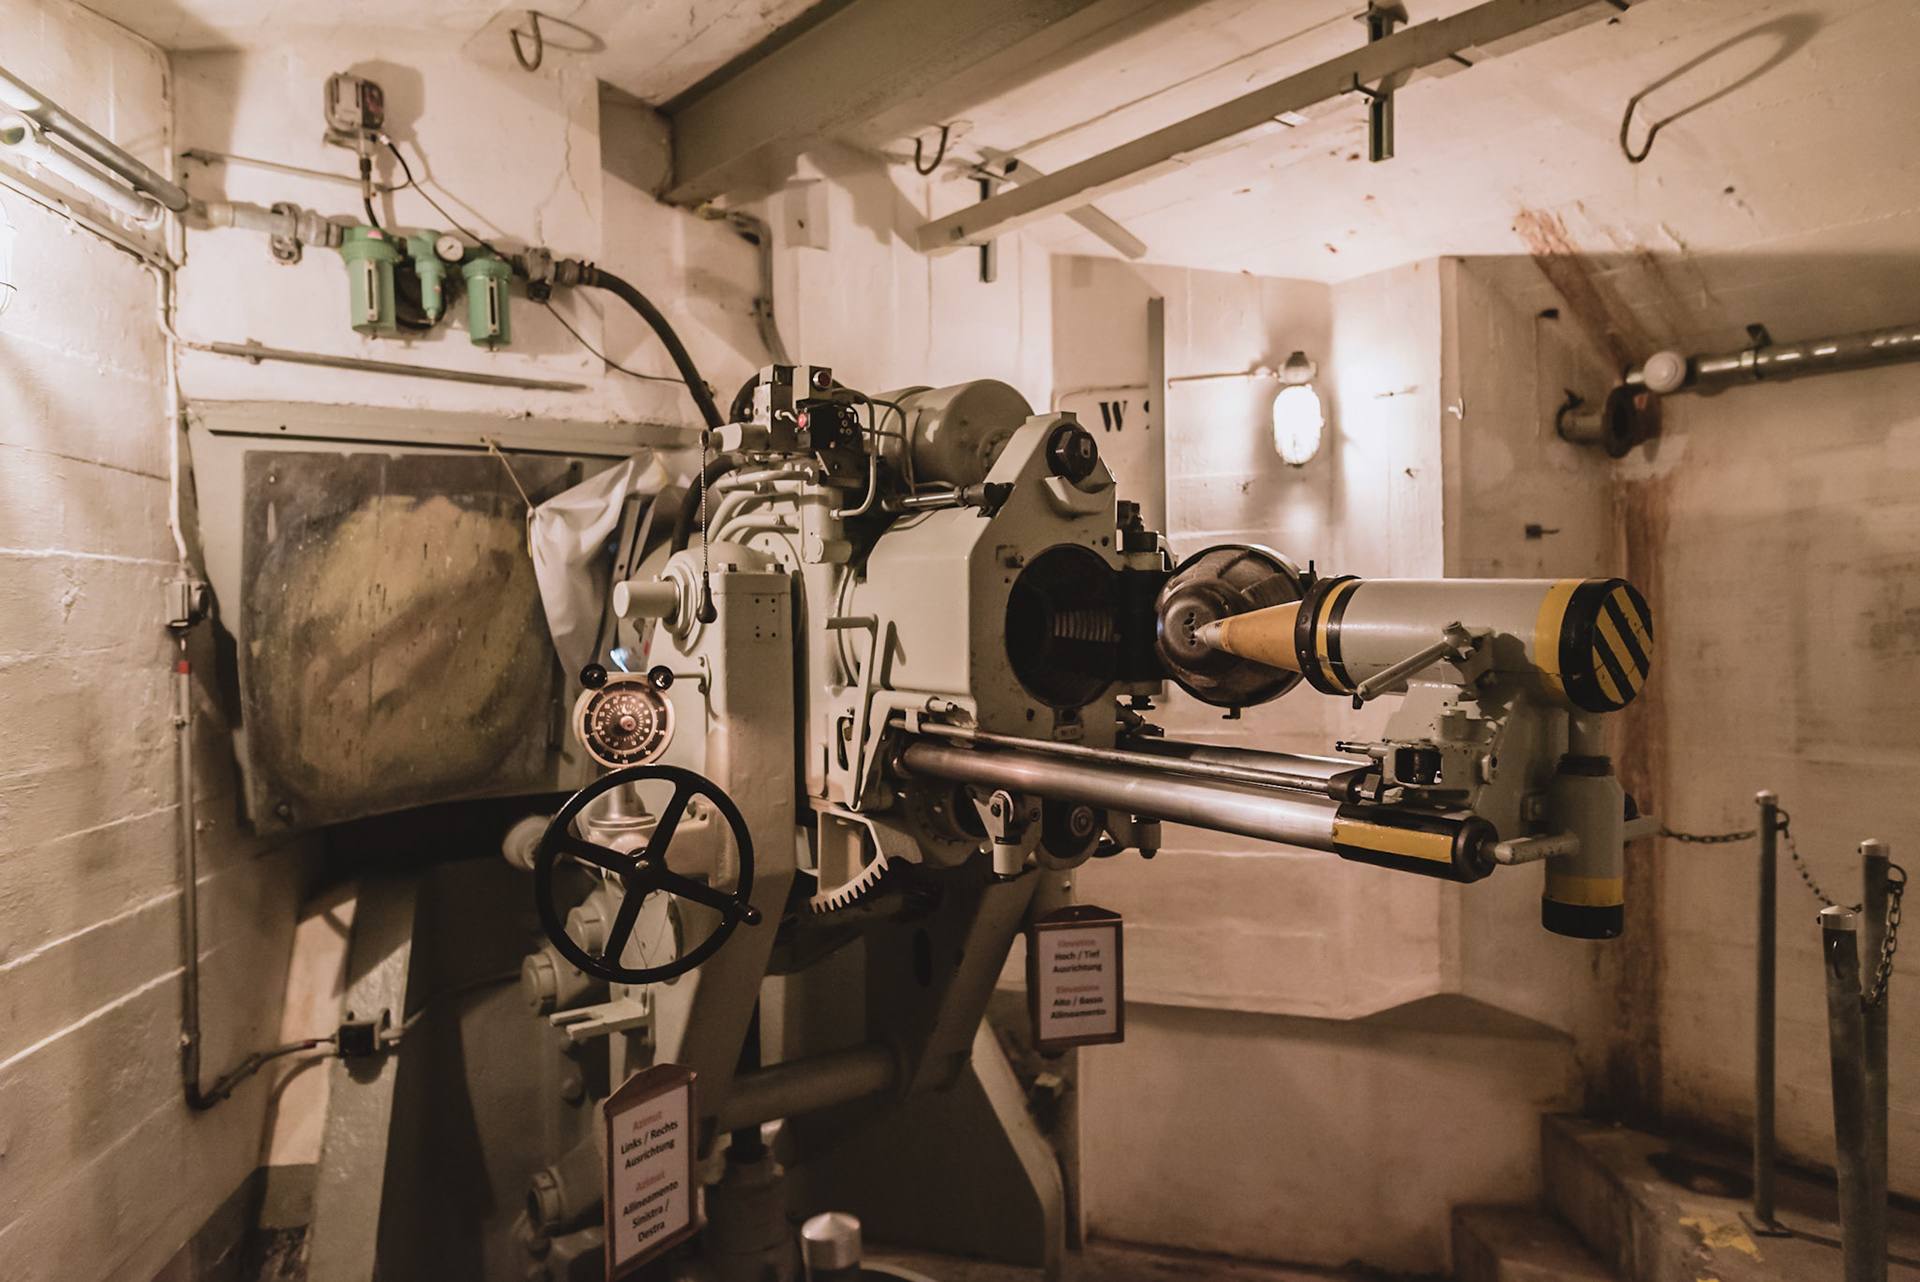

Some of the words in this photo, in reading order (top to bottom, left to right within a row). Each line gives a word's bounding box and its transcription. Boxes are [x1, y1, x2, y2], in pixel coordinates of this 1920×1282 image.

[1098, 400, 1128, 432] W
[1054, 952, 1076, 960] Hoch
[1084, 949, 1100, 959] Tief
[1052, 963, 1102, 973] Ausrichtung
[1053, 998, 1072, 1006] Alto
[1079, 996, 1104, 1005] Basso
[1050, 1008, 1106, 1019] Allineamento
[633, 1111, 662, 1132] Azimut
[621, 1137, 642, 1155] Links
[651, 1121, 678, 1140] Rechts
[625, 1138, 675, 1170] Ausrichtung
[636, 1171, 665, 1192] Azimut
[623, 1181, 678, 1218] Allineamento
[632, 1205, 663, 1229] Sinistra
[638, 1220, 665, 1242] Destra
